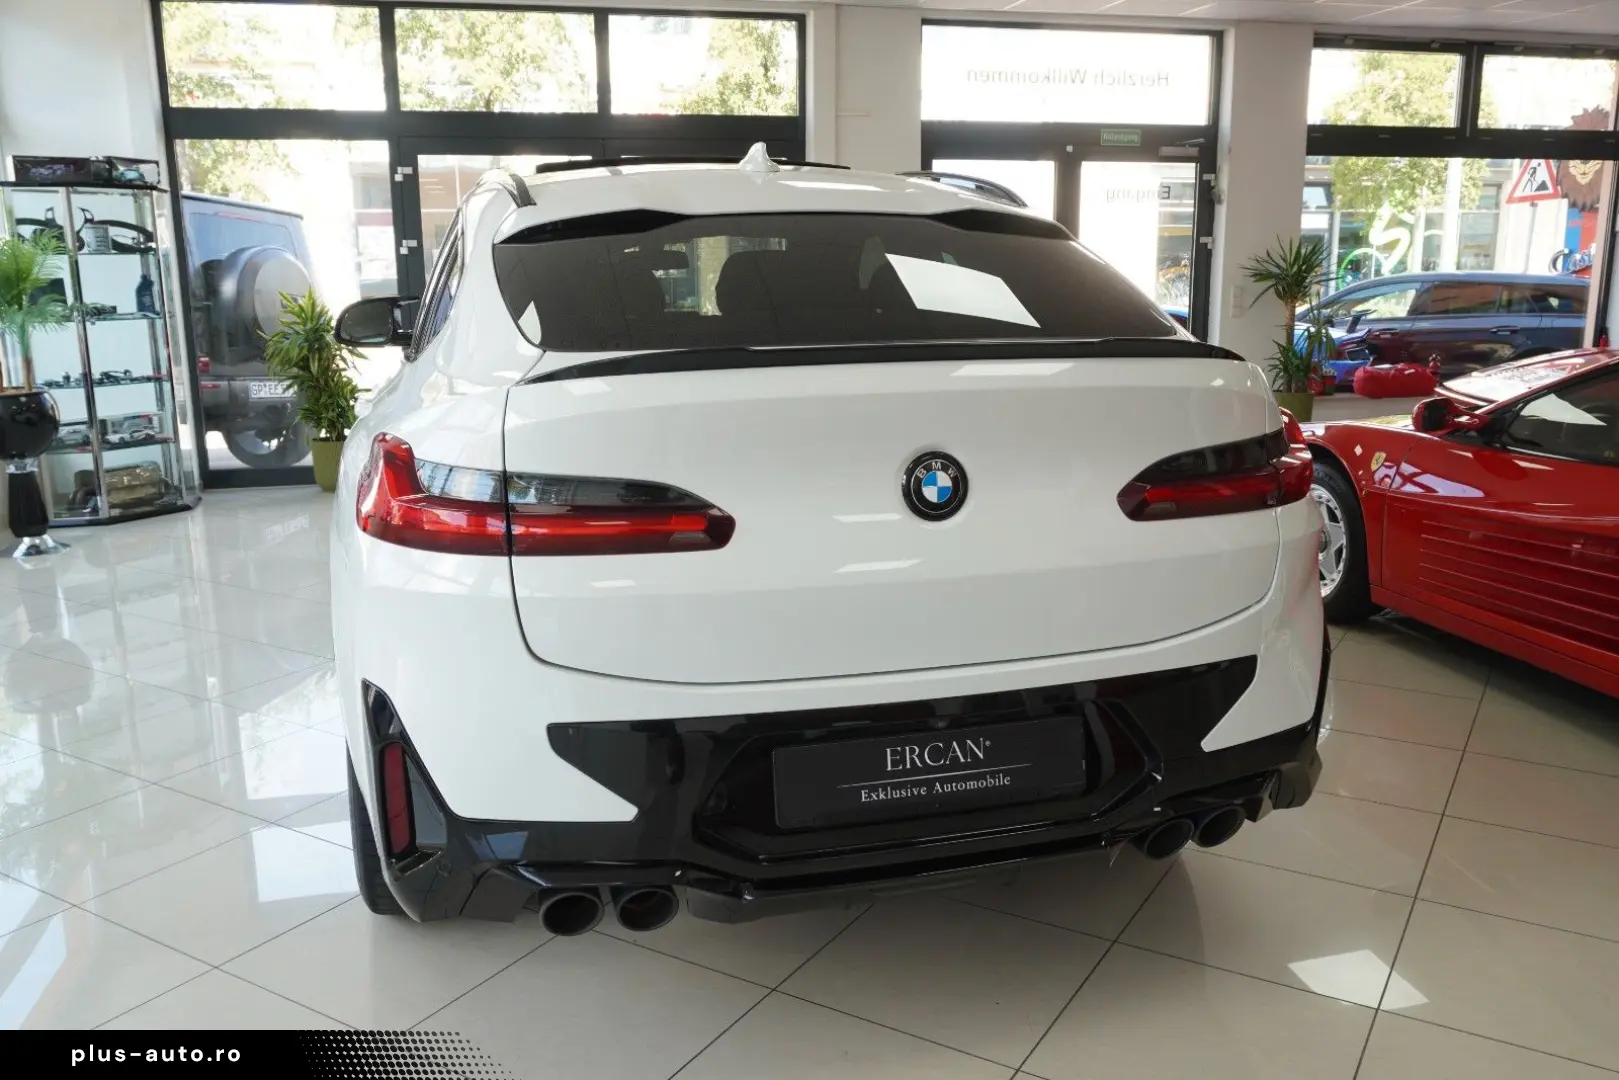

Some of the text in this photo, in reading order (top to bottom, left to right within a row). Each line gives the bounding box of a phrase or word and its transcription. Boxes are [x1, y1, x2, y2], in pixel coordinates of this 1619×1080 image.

[917, 461, 958, 479] BMW
[860, 772, 1011, 802] Exklusive Automobile
